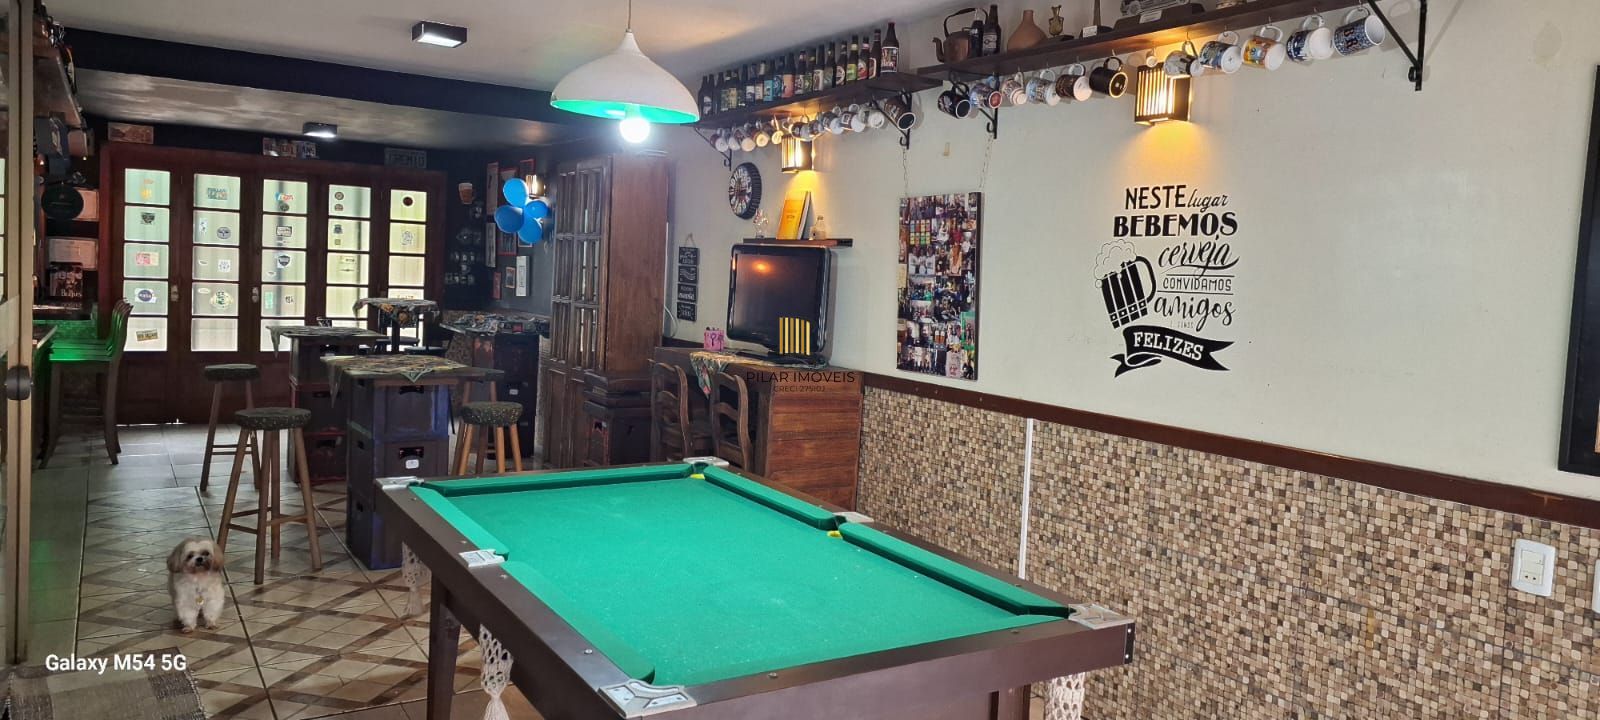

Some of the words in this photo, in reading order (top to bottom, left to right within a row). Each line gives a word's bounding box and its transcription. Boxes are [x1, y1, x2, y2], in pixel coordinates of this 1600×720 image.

[1125, 185, 1187, 210] NESTE
[1187, 189, 1229, 212] lugar
[1113, 212, 1238, 238] BEBEMOS
[1158, 236, 1240, 277] cerveja
[1162, 275, 1232, 292] CONVIDAMOS
[1154, 295, 1236, 332] amigos
[1133, 331, 1204, 361] FELIZES
